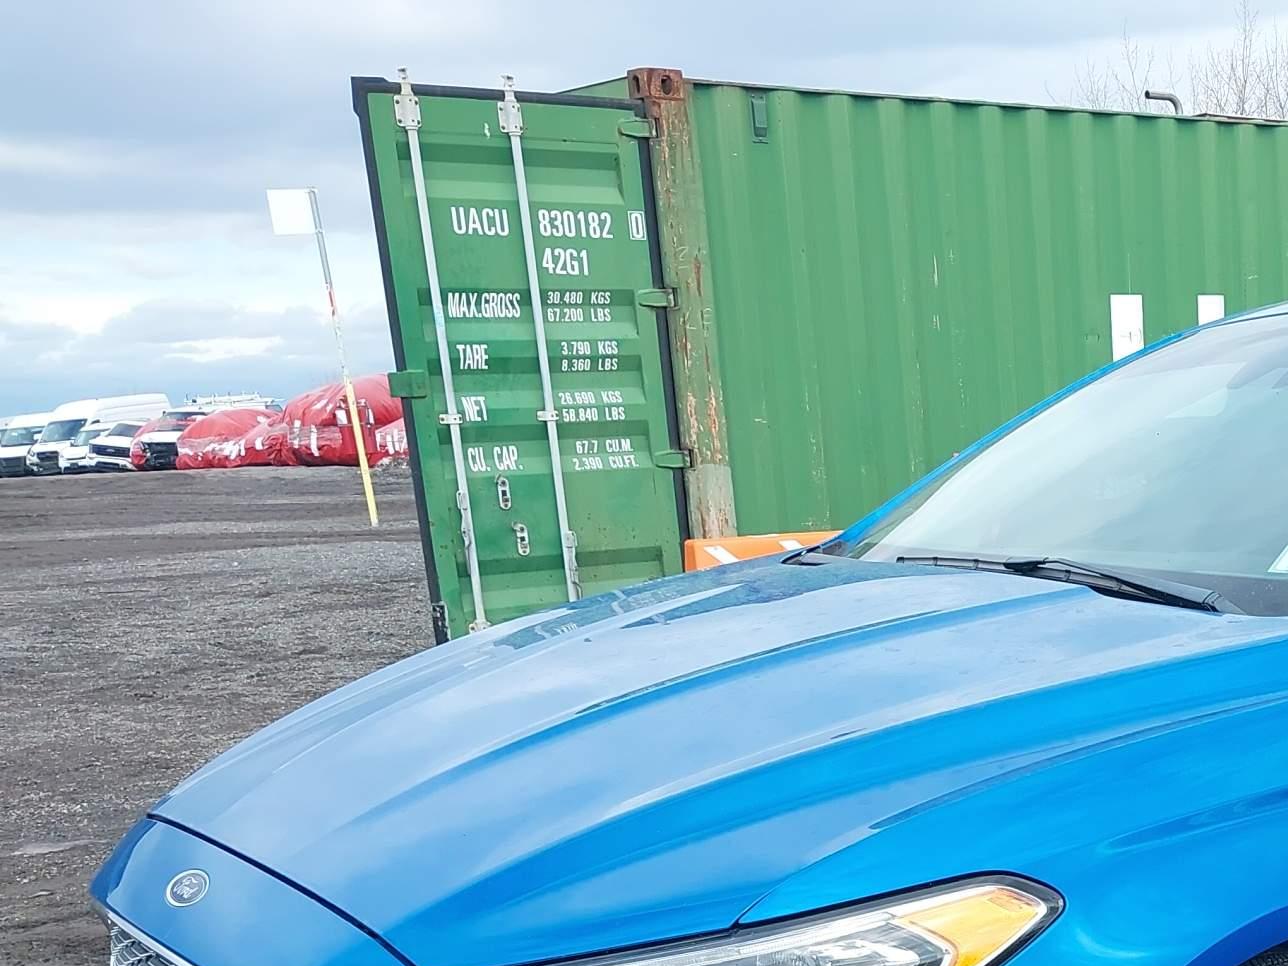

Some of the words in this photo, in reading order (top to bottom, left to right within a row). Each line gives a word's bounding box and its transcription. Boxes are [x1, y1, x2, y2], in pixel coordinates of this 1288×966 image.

[450, 206, 509, 236] UACU
[538, 208, 613, 239] 830182
[542, 247, 589, 276] 42G1
[447, 292, 520, 319] MAX.GROSS
[547, 291, 583, 305] 30.480
[591, 291, 611, 305] KGS
[547, 308, 583, 322] 67.200
[591, 308, 611, 322] LBS
[561, 341, 591, 355] 3.790
[598, 340, 619, 355] KGS
[456, 343, 489, 370] TARE
[561, 358, 591, 372] 8.360
[598, 357, 618, 371] LBS
[559, 391, 596, 405] 26.690
[601, 390, 623, 404] KGS
[461, 395, 488, 422] NET
[562, 407, 599, 422] 58.840
[605, 406, 626, 421] LBS
[575, 439, 598, 454] 67.7
[467, 447, 491, 472] CU.
[493, 445, 524, 471] CAP.
[572, 457, 602, 471] 2.390
